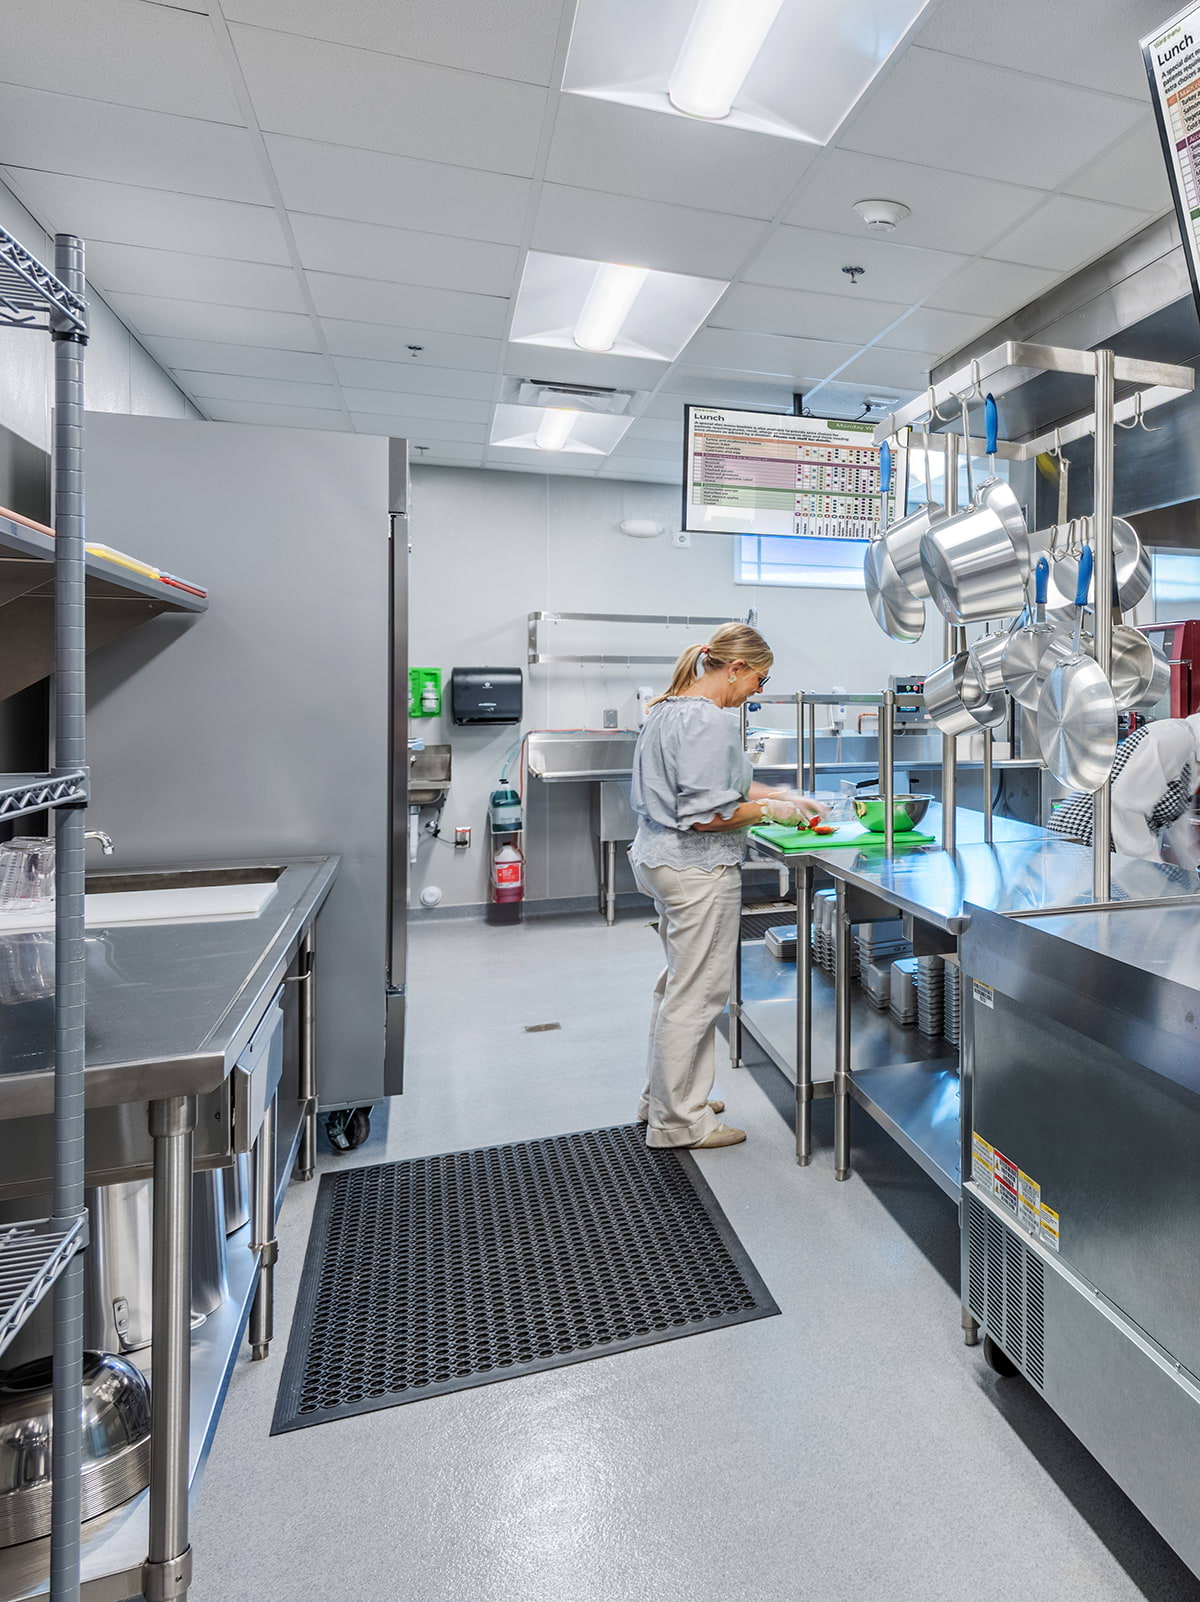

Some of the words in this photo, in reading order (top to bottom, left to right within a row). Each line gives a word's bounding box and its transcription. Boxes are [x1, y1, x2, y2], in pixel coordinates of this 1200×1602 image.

[1158, 33, 1193, 67] Lunch
[1161, 71, 1166, 79] A
[1167, 60, 1183, 77] special
[1184, 52, 1194, 63] diet
[1163, 69, 1183, 87] patients
[1165, 82, 1177, 95] extra
[1178, 69, 1196, 86] choices
[1182, 93, 1196, 107] Turkey
[1183, 101, 1200, 115] Salmon
[1187, 121, 1197, 131] Cold
[694, 413, 725, 421] Lunch
